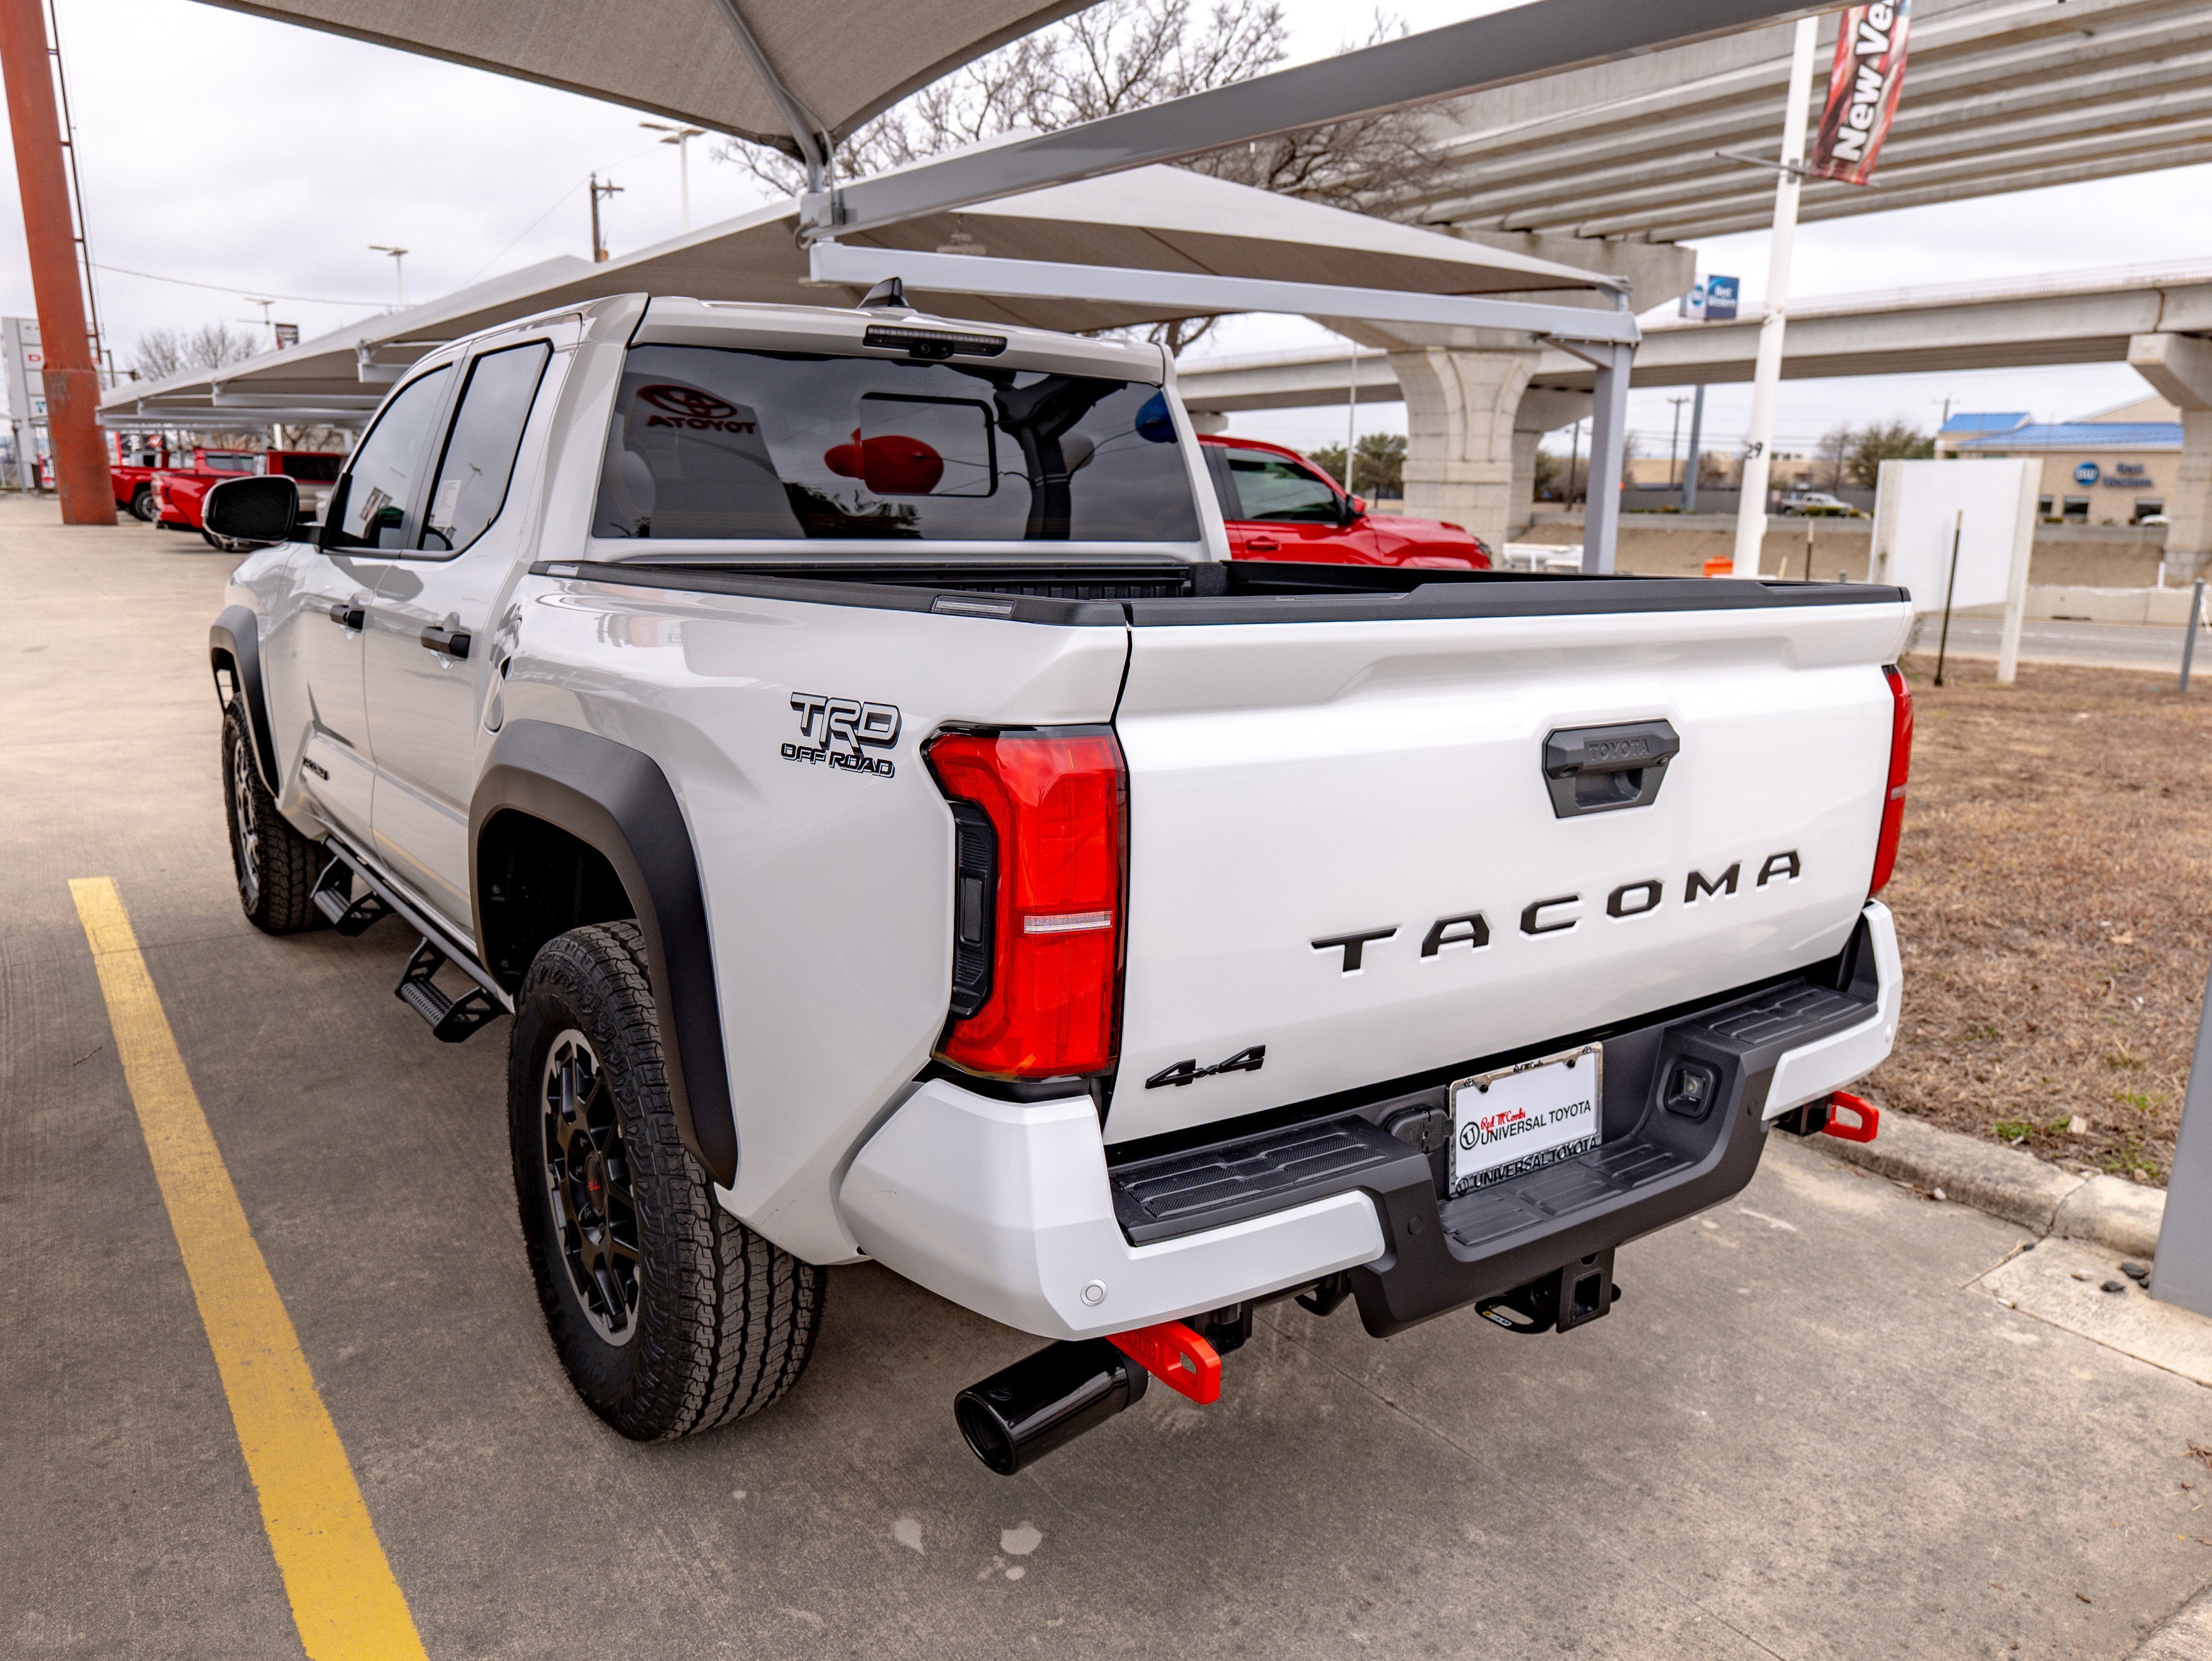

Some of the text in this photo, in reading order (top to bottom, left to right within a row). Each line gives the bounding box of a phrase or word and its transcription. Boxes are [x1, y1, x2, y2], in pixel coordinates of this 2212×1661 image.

[1831, 0, 1895, 162] New Ve
[1743, 441, 1763, 459] 29
[790, 691, 903, 754] TRD
[781, 743, 895, 778] OFF ROAD
[1588, 739, 1650, 761] TOYOTA
[1310, 849, 1802, 974] TACOMA
[1480, 1115, 1495, 1133] Red
[1481, 1114, 1547, 1145] UNIVERSAL
[1548, 1099, 1591, 1123] TOYOTA
[1474, 1152, 1548, 1188] UNIVERSAL
[1548, 1136, 1598, 1162] TOYOTA
